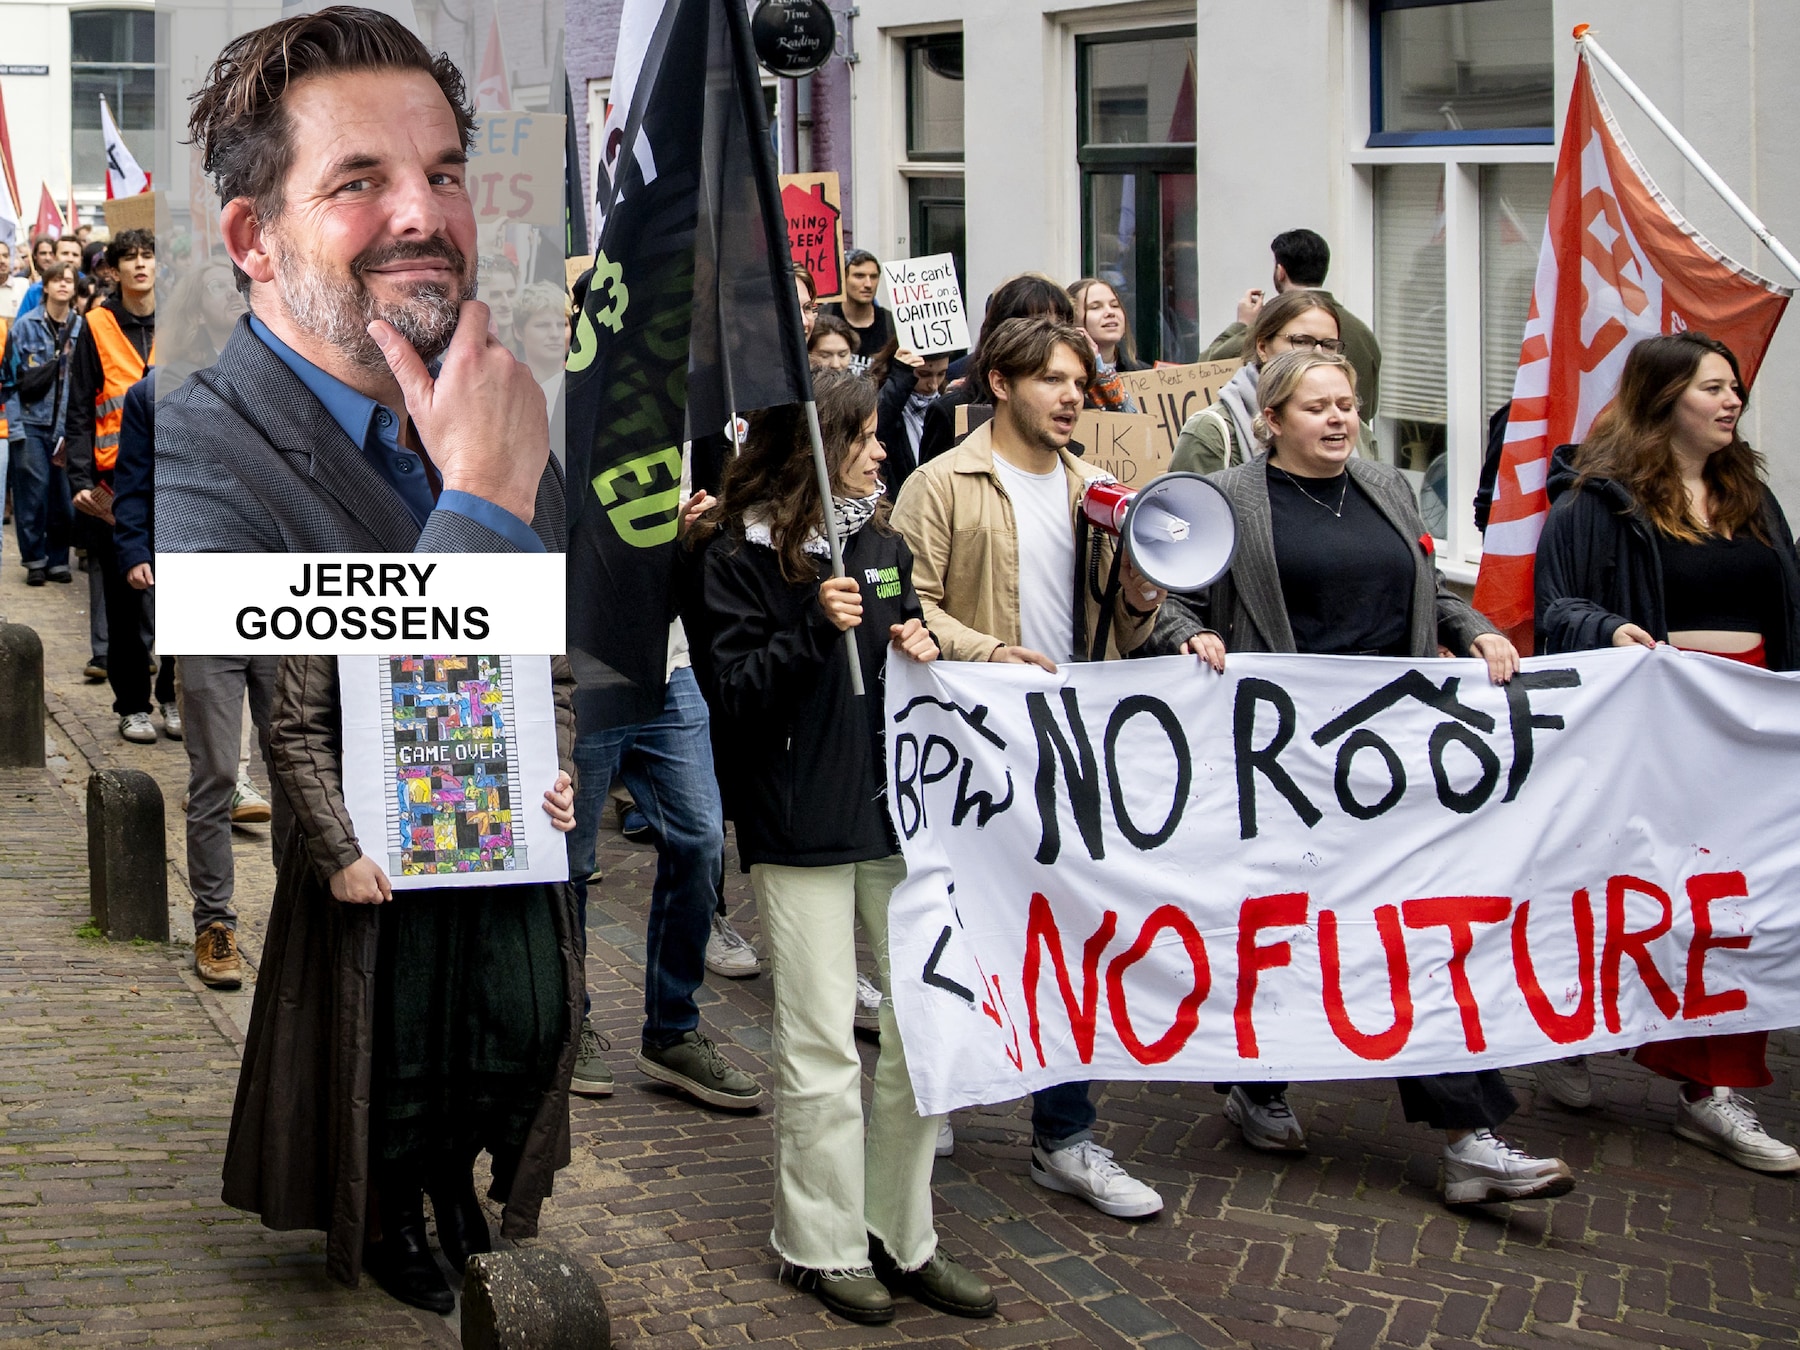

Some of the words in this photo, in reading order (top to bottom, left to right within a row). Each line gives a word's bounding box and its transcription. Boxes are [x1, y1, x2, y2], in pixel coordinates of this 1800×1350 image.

[784, 9, 810, 22] Time
[776, 35, 820, 50] Reading
[786, 54, 811, 65] Time
[885, 264, 915, 284] We
[921, 262, 952, 281] can't
[893, 284, 933, 305] LIVE
[937, 288, 949, 298] on
[952, 286, 959, 296] a
[897, 300, 958, 323] WAITING
[910, 319, 953, 350] LIST
[1120, 374, 1151, 394] The
[1156, 370, 1183, 387] Rent
[1199, 366, 1212, 379] too
[399, 744, 451, 764] GAME
[455, 742, 505, 761] OVER
[1025, 687, 1193, 865] NO
[1232, 668, 1582, 840] ROOF
[1022, 892, 1212, 1069] NO
[1232, 871, 1753, 1061] FUTURE
